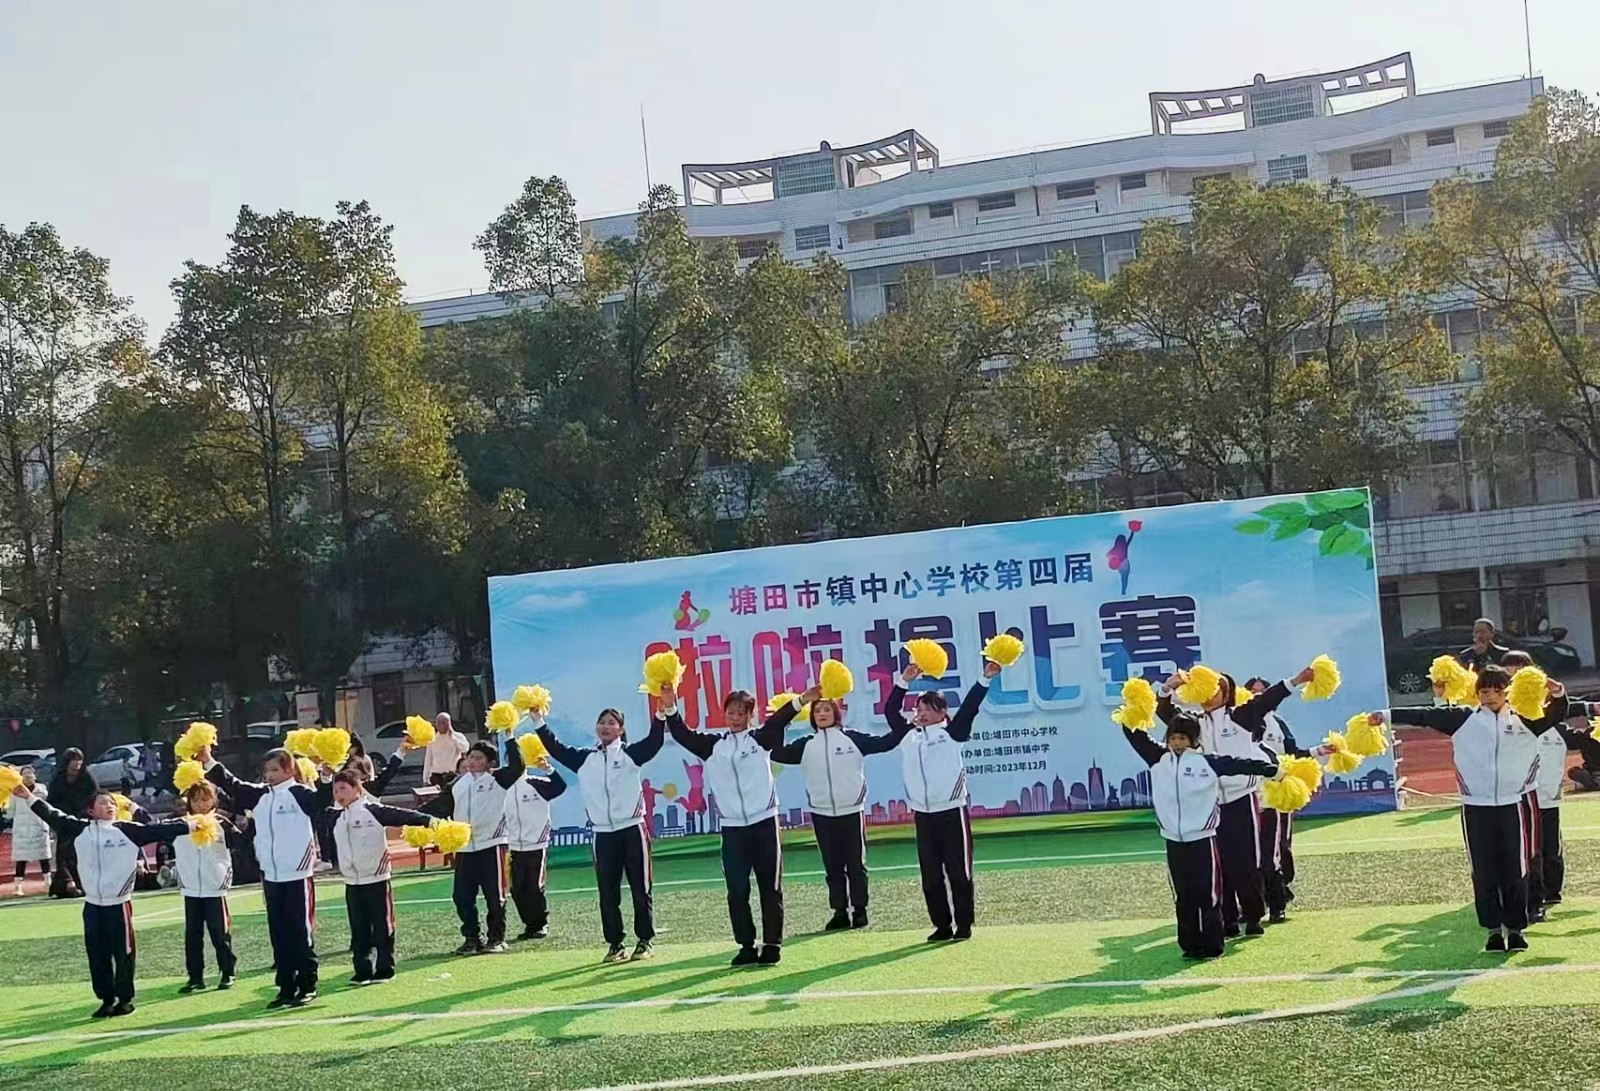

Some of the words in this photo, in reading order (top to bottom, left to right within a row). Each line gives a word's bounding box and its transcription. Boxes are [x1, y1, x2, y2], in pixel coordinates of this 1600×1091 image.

[729, 552, 1094, 615] 塘田市镇中心学校第四届
[961, 743, 1050, 759] 办单位:塘田市镇中学
